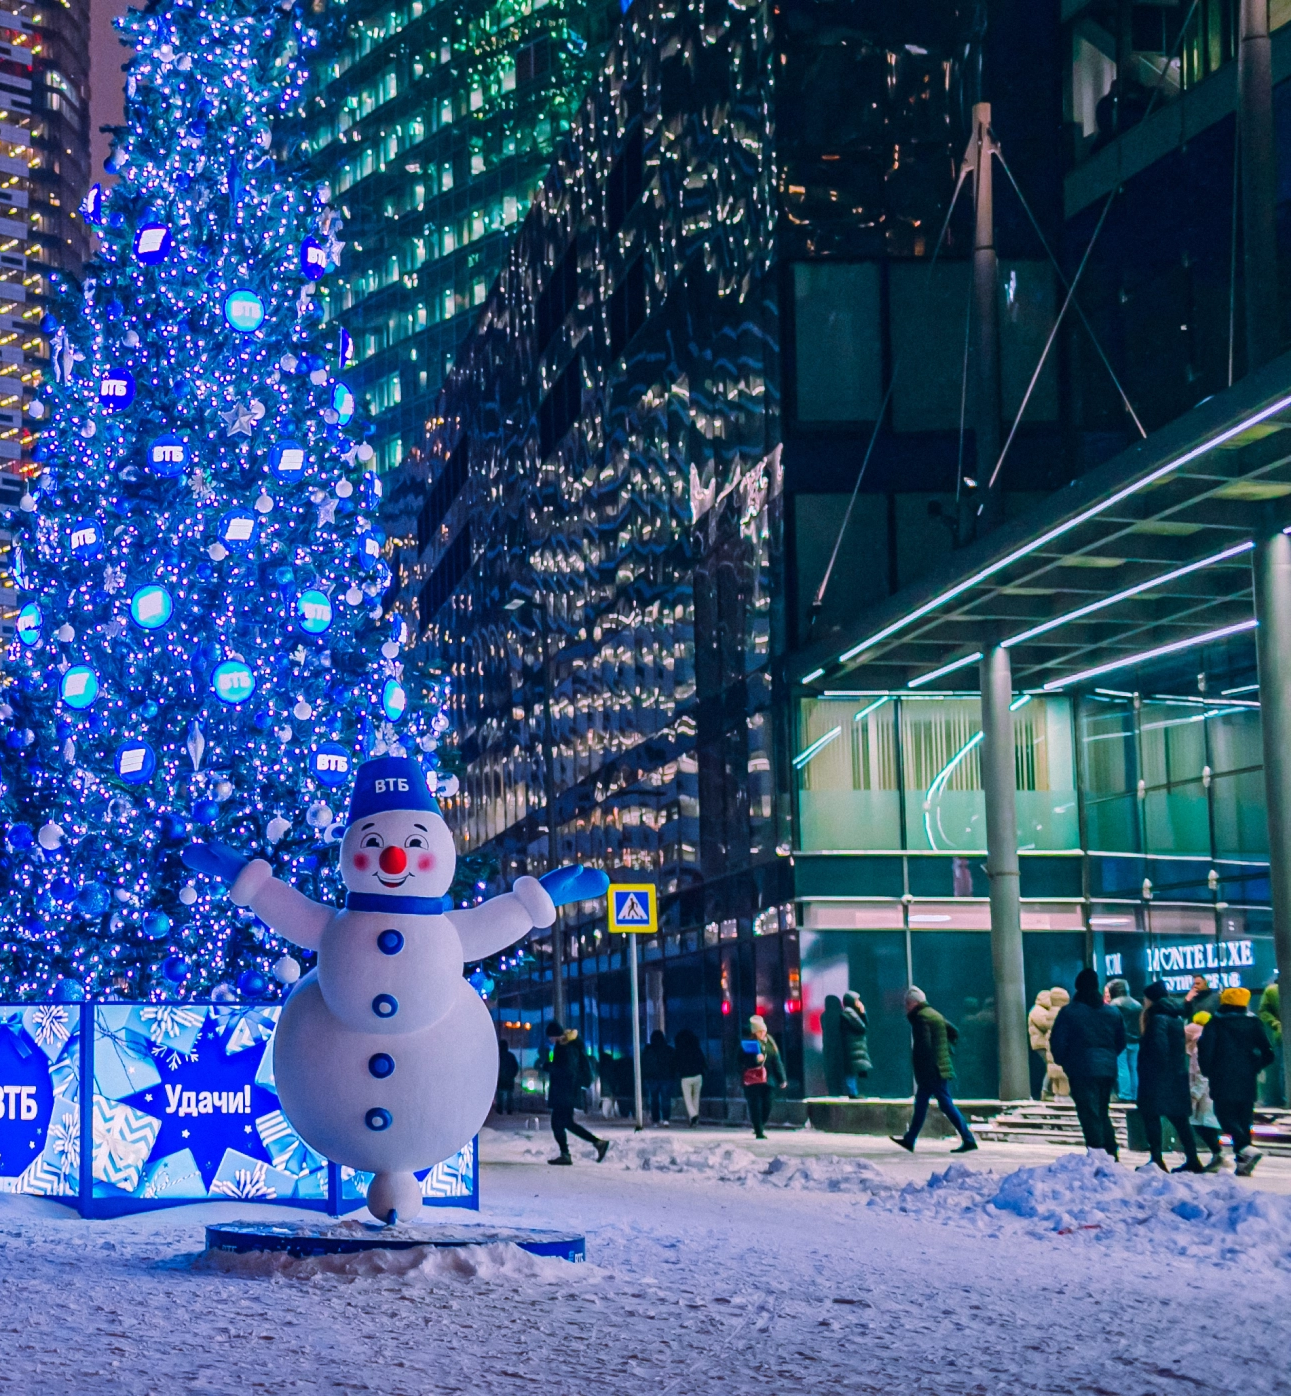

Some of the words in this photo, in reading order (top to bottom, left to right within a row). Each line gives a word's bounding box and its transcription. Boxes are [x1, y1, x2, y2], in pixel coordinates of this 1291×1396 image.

[153, 446, 184, 462] ВТБ
[219, 672, 251, 689] ВТБ
[317, 754, 347, 772] ВТБ
[375, 778, 409, 793] ВТБ
[165, 1083, 251, 1117] Удачи!
